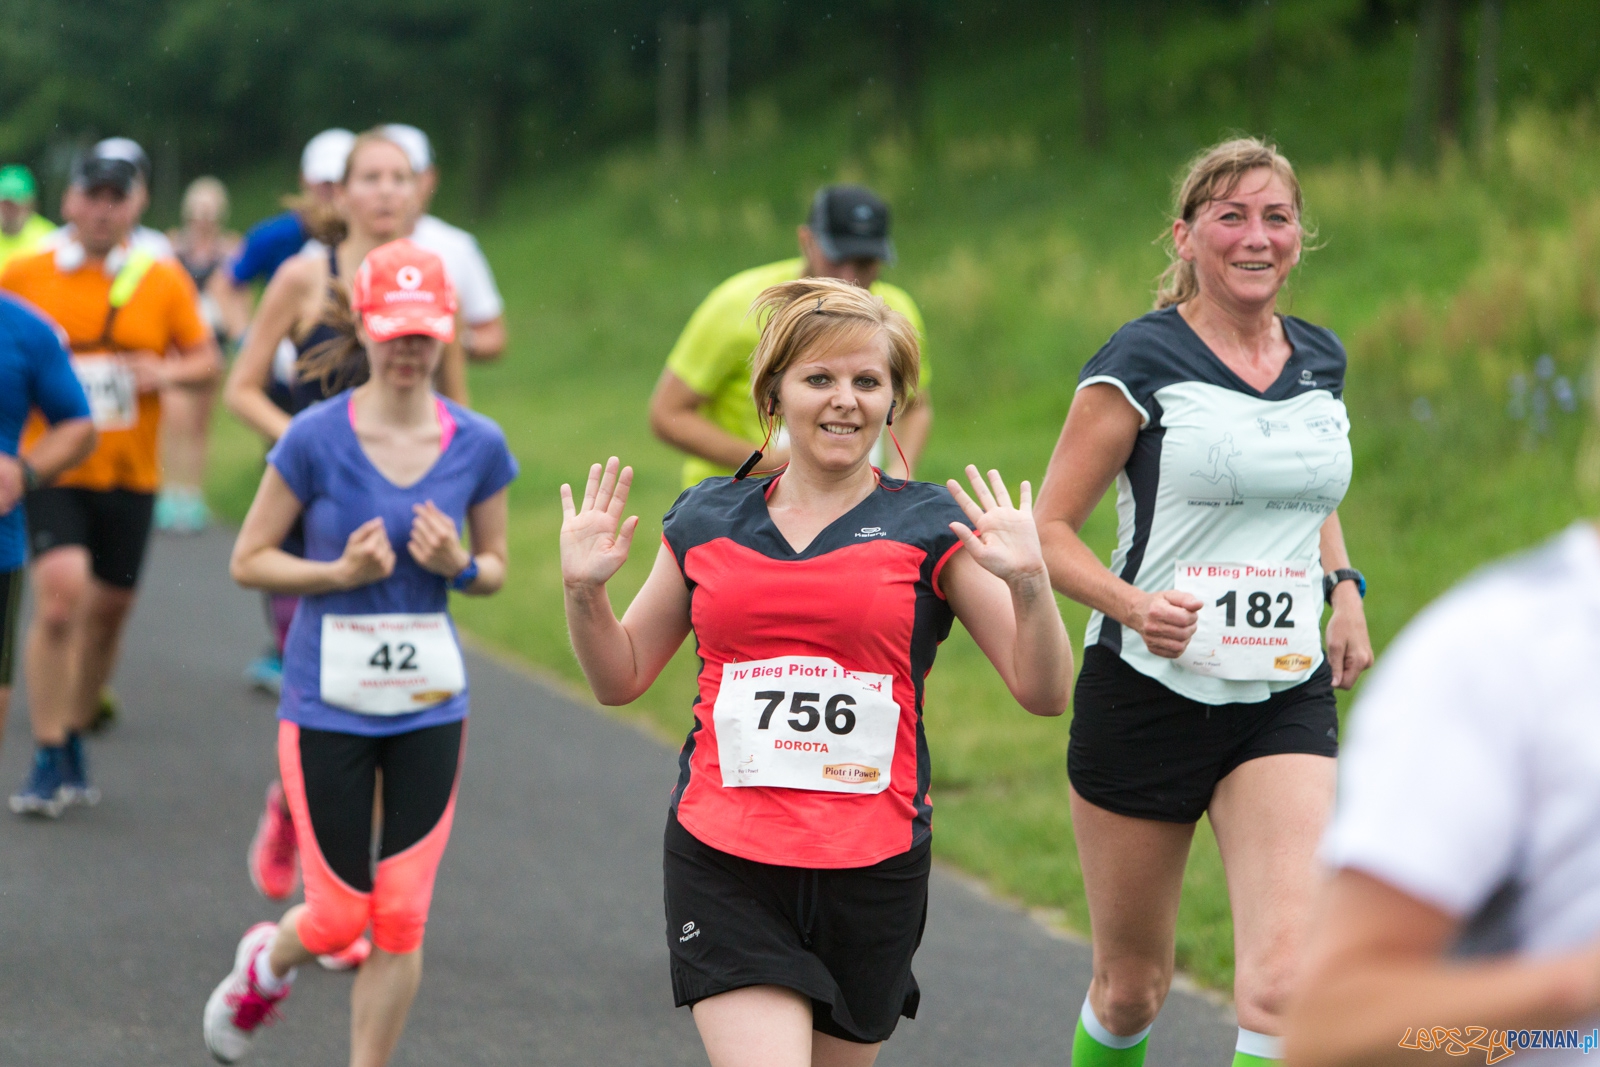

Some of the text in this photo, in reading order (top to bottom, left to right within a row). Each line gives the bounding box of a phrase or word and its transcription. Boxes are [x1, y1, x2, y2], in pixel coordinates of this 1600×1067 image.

[1187, 566, 1202, 576] IV
[1207, 566, 1240, 579] Bieg
[1246, 566, 1276, 577] Piotr
[1216, 590, 1294, 628] 182
[1221, 636, 1288, 646] MAGDALENA
[368, 643, 418, 671] 42
[733, 663, 837, 681] IV Bieg Piotr i
[754, 690, 857, 735] 756
[774, 739, 829, 753] DOROTA
[825, 767, 847, 776] Piotr
